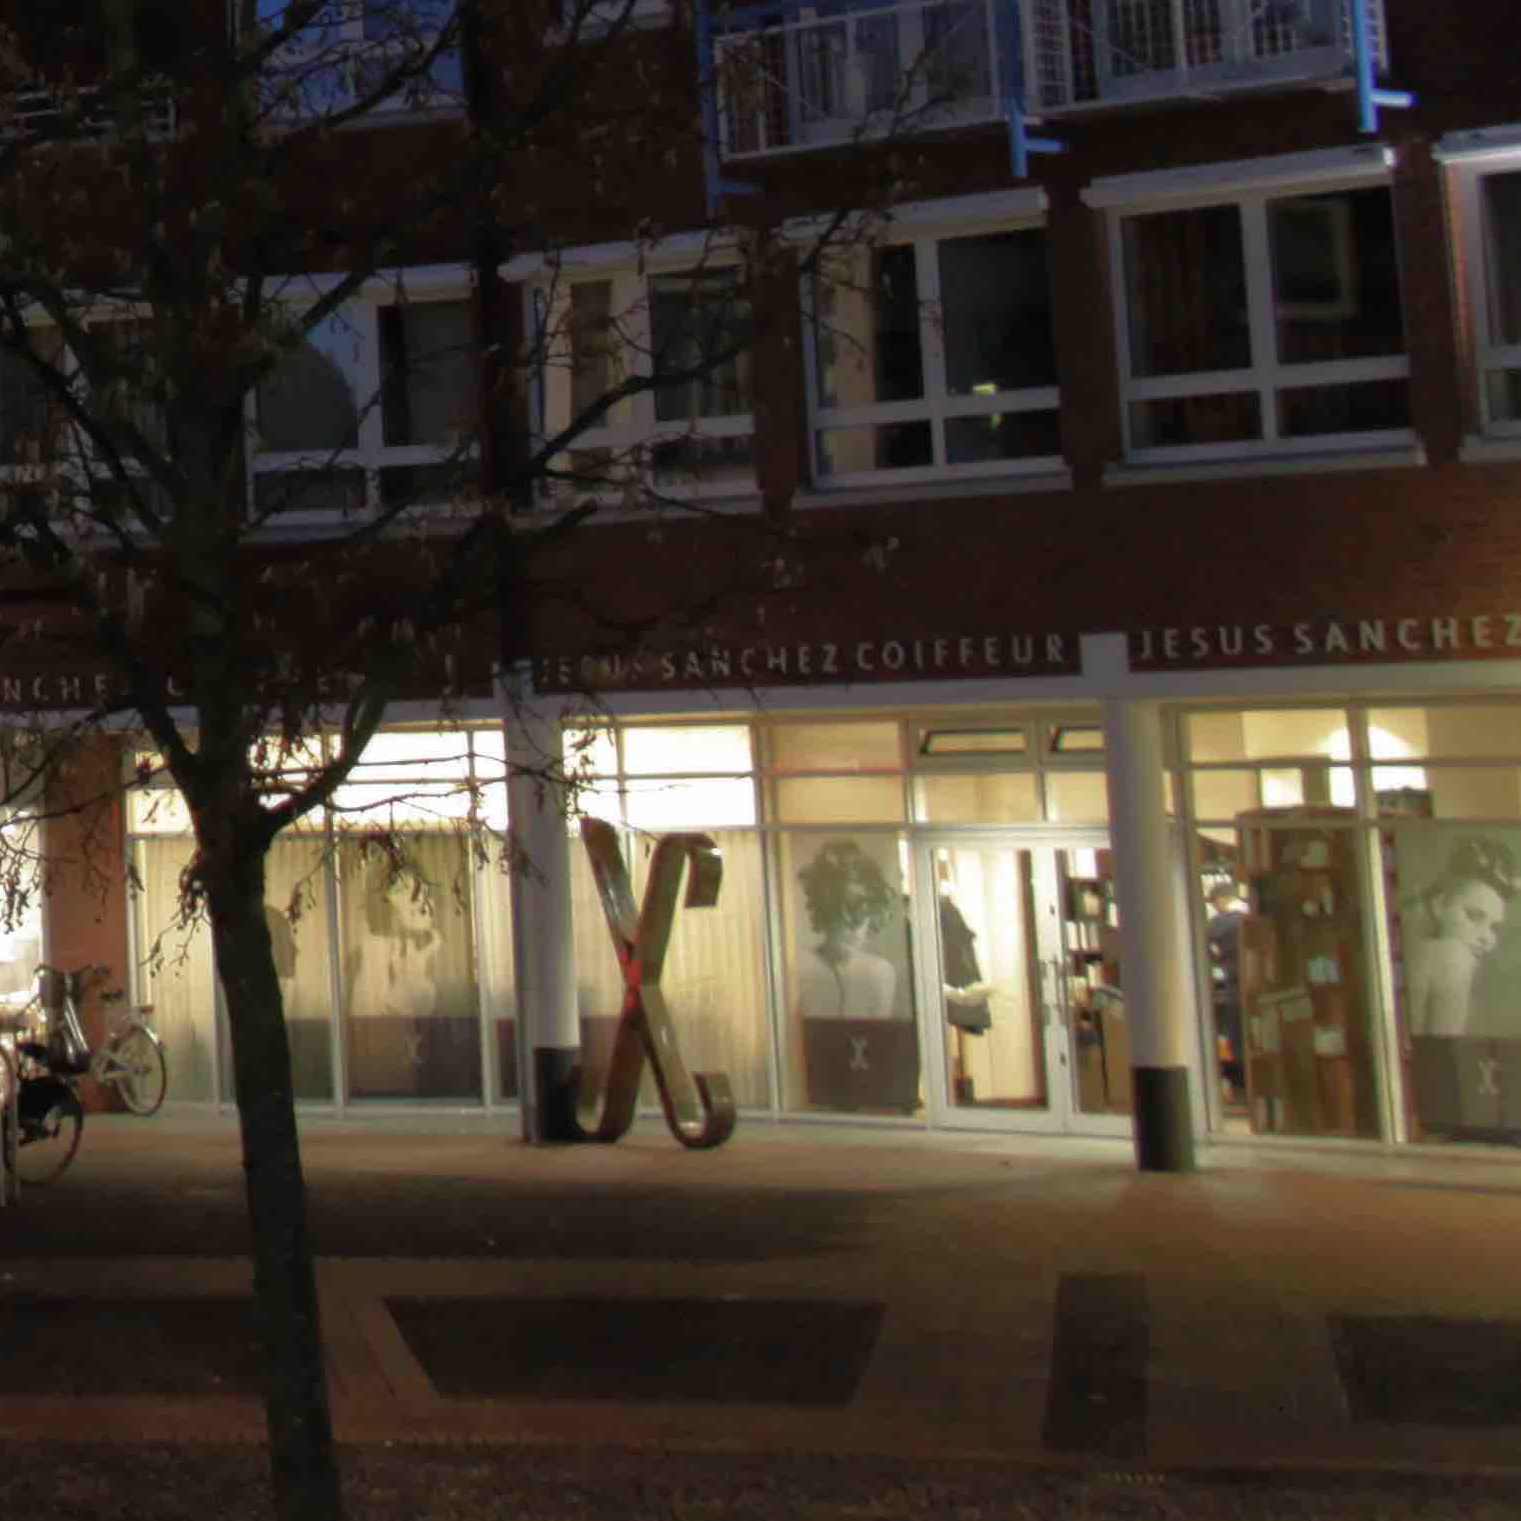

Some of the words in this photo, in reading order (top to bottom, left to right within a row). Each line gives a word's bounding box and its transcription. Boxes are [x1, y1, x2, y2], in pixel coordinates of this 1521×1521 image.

[660, 642, 839, 681] SANCHEZ
[858, 633, 1064, 672] COIFFEUR
[1139, 623, 1275, 661] JESUS
[1292, 614, 1521, 656] SANCHEZ
